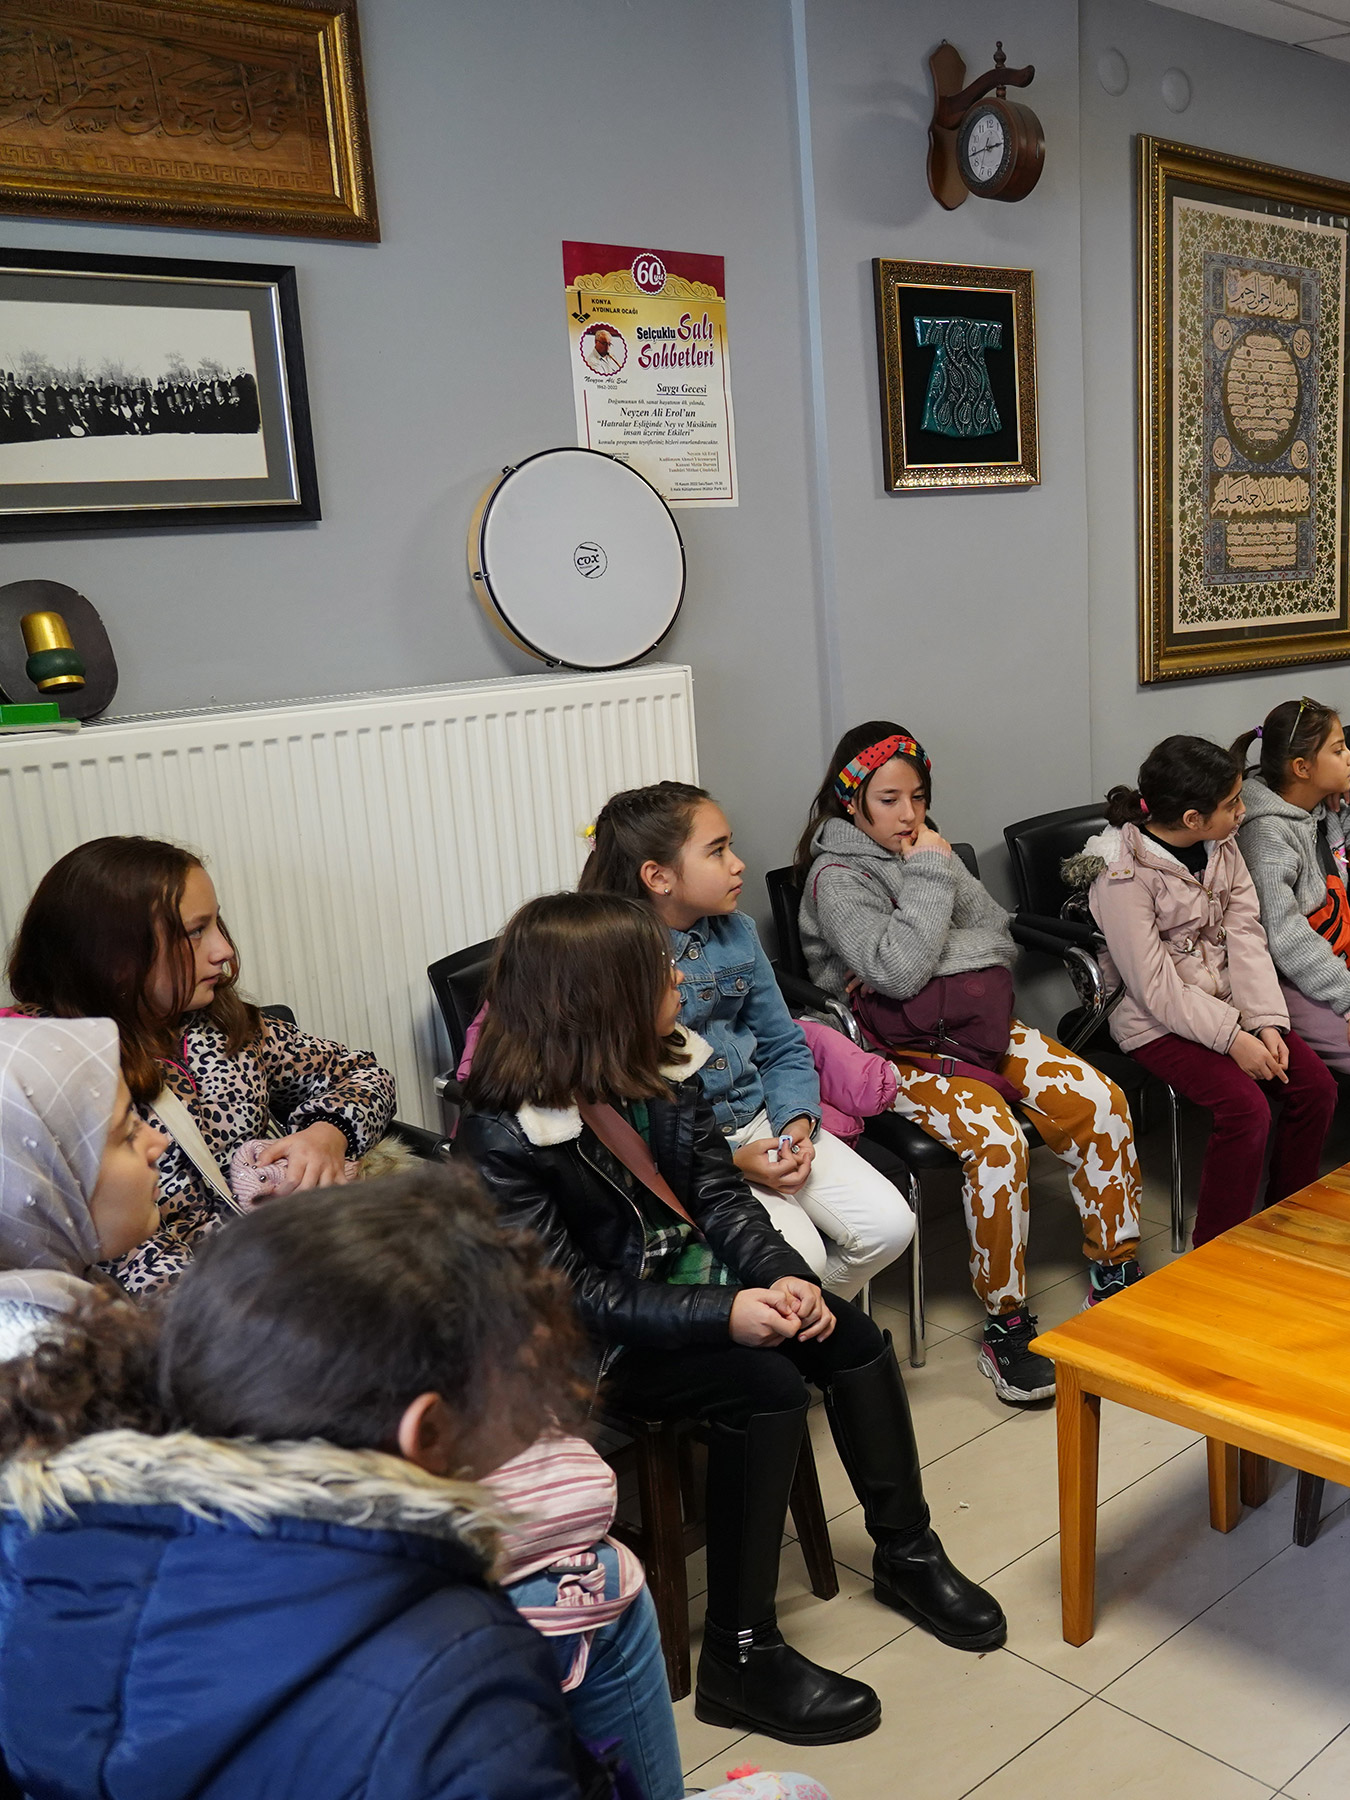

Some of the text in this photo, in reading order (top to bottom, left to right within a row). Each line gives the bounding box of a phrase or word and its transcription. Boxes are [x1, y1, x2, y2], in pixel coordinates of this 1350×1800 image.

[592, 306, 621, 314] AYDINLAR
[636, 312, 713, 342] Selçuklu Salı
[637, 343, 714, 370] Sohbetleri
[656, 382, 707, 395] Saygı Gecesi
[620, 407, 649, 418] Neyzen
[651, 407, 663, 417] Ali
[664, 420, 677, 429] Ney
[643, 429, 666, 437] üzerine
